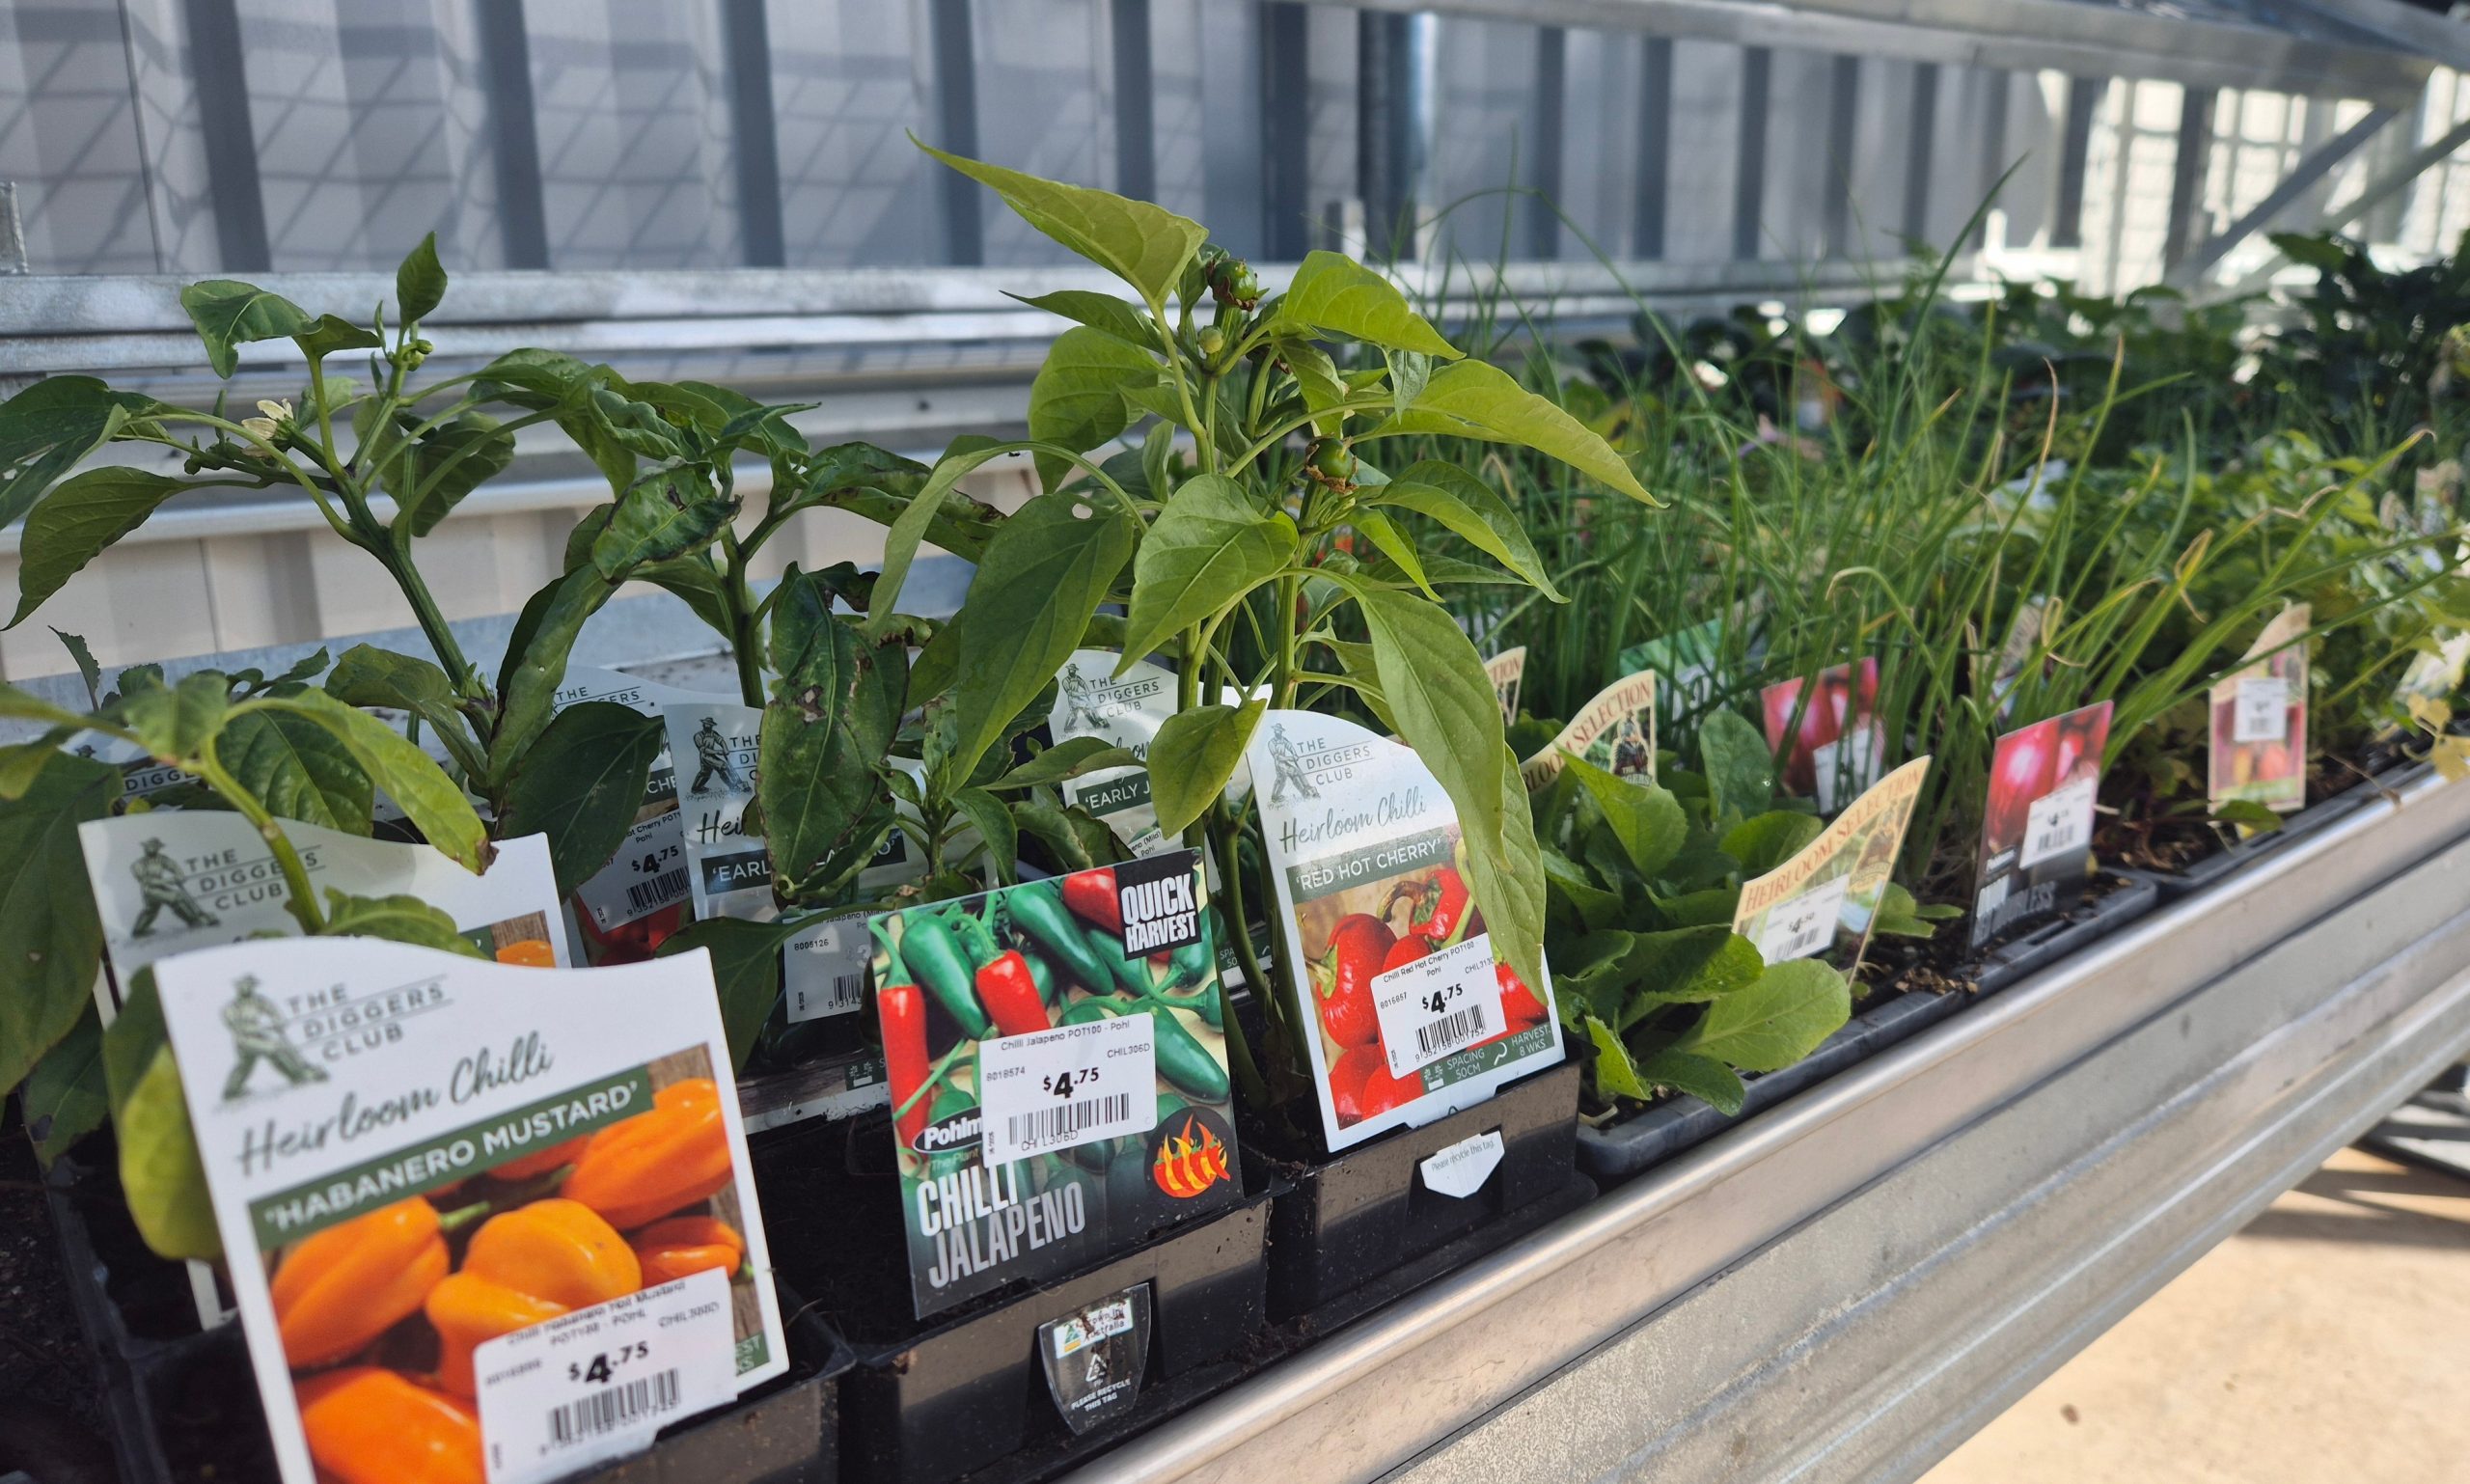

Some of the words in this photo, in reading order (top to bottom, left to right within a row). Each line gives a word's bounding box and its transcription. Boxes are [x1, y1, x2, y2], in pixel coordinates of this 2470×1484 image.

[557, 686, 589, 701] THE
[1090, 677, 1117, 689] THE
[1098, 682, 1160, 703] DIGGERS
[1107, 701, 1142, 718] CLUB
[1573, 681, 1651, 751] SELECTION
[729, 733, 760, 749] THE
[1298, 737, 1327, 754] THE
[1306, 746, 1372, 770] DIGGERS
[125, 769, 196, 792] DIGG
[1316, 768, 1354, 786] CLUB
[1279, 808, 1374, 854] Heirloom
[1378, 785, 1427, 827] Chilli
[185, 848, 237, 871] THE
[199, 852, 317, 893] DIGGES
[631, 845, 679, 874] $4.75
[712, 860, 772, 882] 'EARL
[1339, 857, 1371, 881] HOT
[214, 882, 283, 910] CLUB
[1120, 873, 1193, 925] QUICK
[1124, 911, 1196, 953] HARVEST
[1384, 968, 1399, 983] Chilli
[1401, 965, 1413, 976] Red
[1414, 960, 1427, 971] Hot
[1428, 952, 1449, 966] Cherry
[1450, 941, 1474, 956] POT100
[1427, 966, 1441, 977] Pohl
[287, 982, 347, 1014] THE
[303, 982, 444, 1039] DIGGERS
[1421, 983, 1463, 1014] $4.75
[321, 1022, 404, 1062] CLUB
[1001, 1040, 1025, 1051] Chilli
[1027, 1032, 1066, 1048] Jalapeno
[1068, 1025, 1102, 1039] POT100
[1111, 1020, 1130, 1031] Pohl
[1519, 1046, 1525, 1058] 8
[1526, 1037, 1546, 1055] WKS
[1447, 1048, 1485, 1071] SPACING
[1456, 1063, 1481, 1081] 50CM
[1043, 1066, 1100, 1099] $4.75
[237, 1087, 442, 1179] Heirloom
[450, 1030, 557, 1106] Chilli
[923, 1115, 982, 1150] Pohlm
[917, 1161, 1019, 1237] CHILLI
[928, 1181, 1085, 1289] JALAPENO
[568, 1340, 649, 1385] $4.75
[1071, 1391, 1096, 1411] PLEASE
[1097, 1378, 1131, 1398] RECYCLE
[1084, 1397, 1102, 1412] THIS
[1103, 1391, 1117, 1405] TAG
